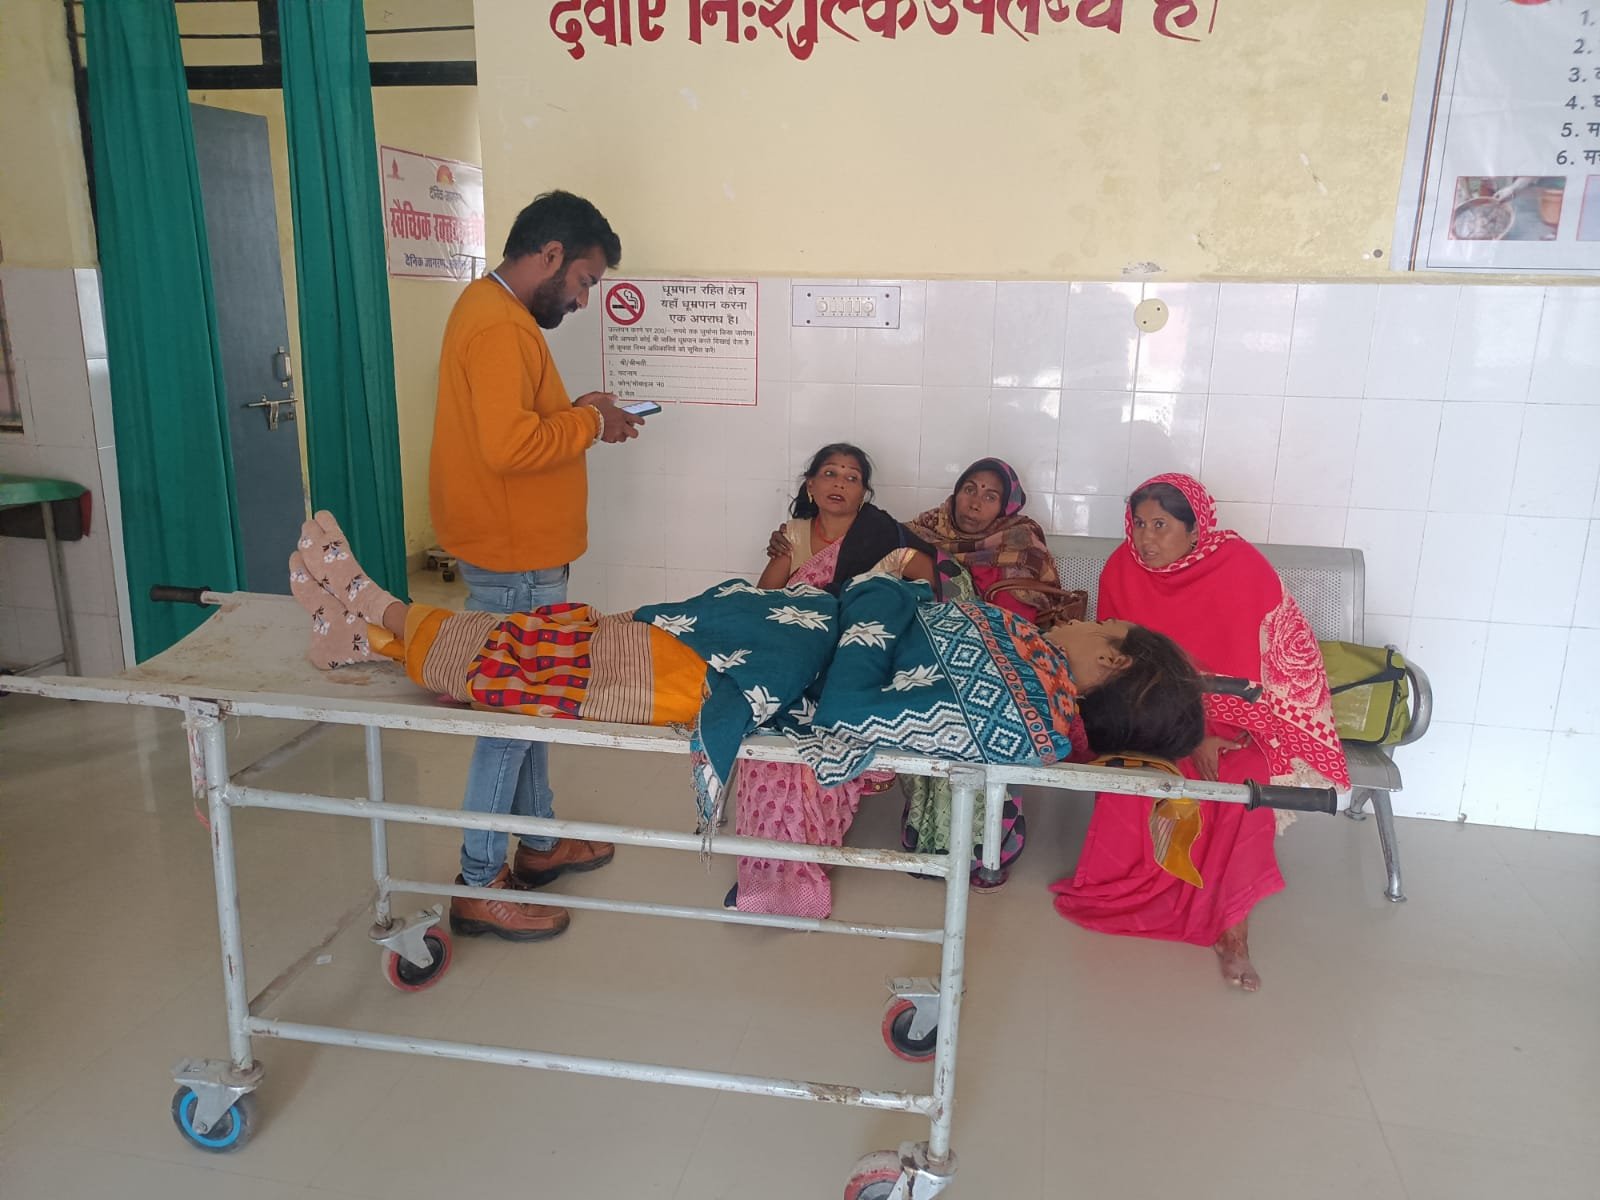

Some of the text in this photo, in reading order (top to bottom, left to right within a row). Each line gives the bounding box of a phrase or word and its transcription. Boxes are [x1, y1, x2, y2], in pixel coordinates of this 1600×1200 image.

[1573, 38, 1592, 54] 2.
[1568, 67, 1587, 83] 3.
[1565, 95, 1585, 110] 4.
[1561, 122, 1579, 137] 5.
[1556, 150, 1574, 165] 6.
[404, 252, 423, 268] दैनिक
[662, 284, 746, 296] धूम्रपान रहित क्षेत्र
[682, 300, 716, 311] धूम्रपान
[720, 301, 747, 310] करना
[669, 313, 739, 325] एक अपराध है।
